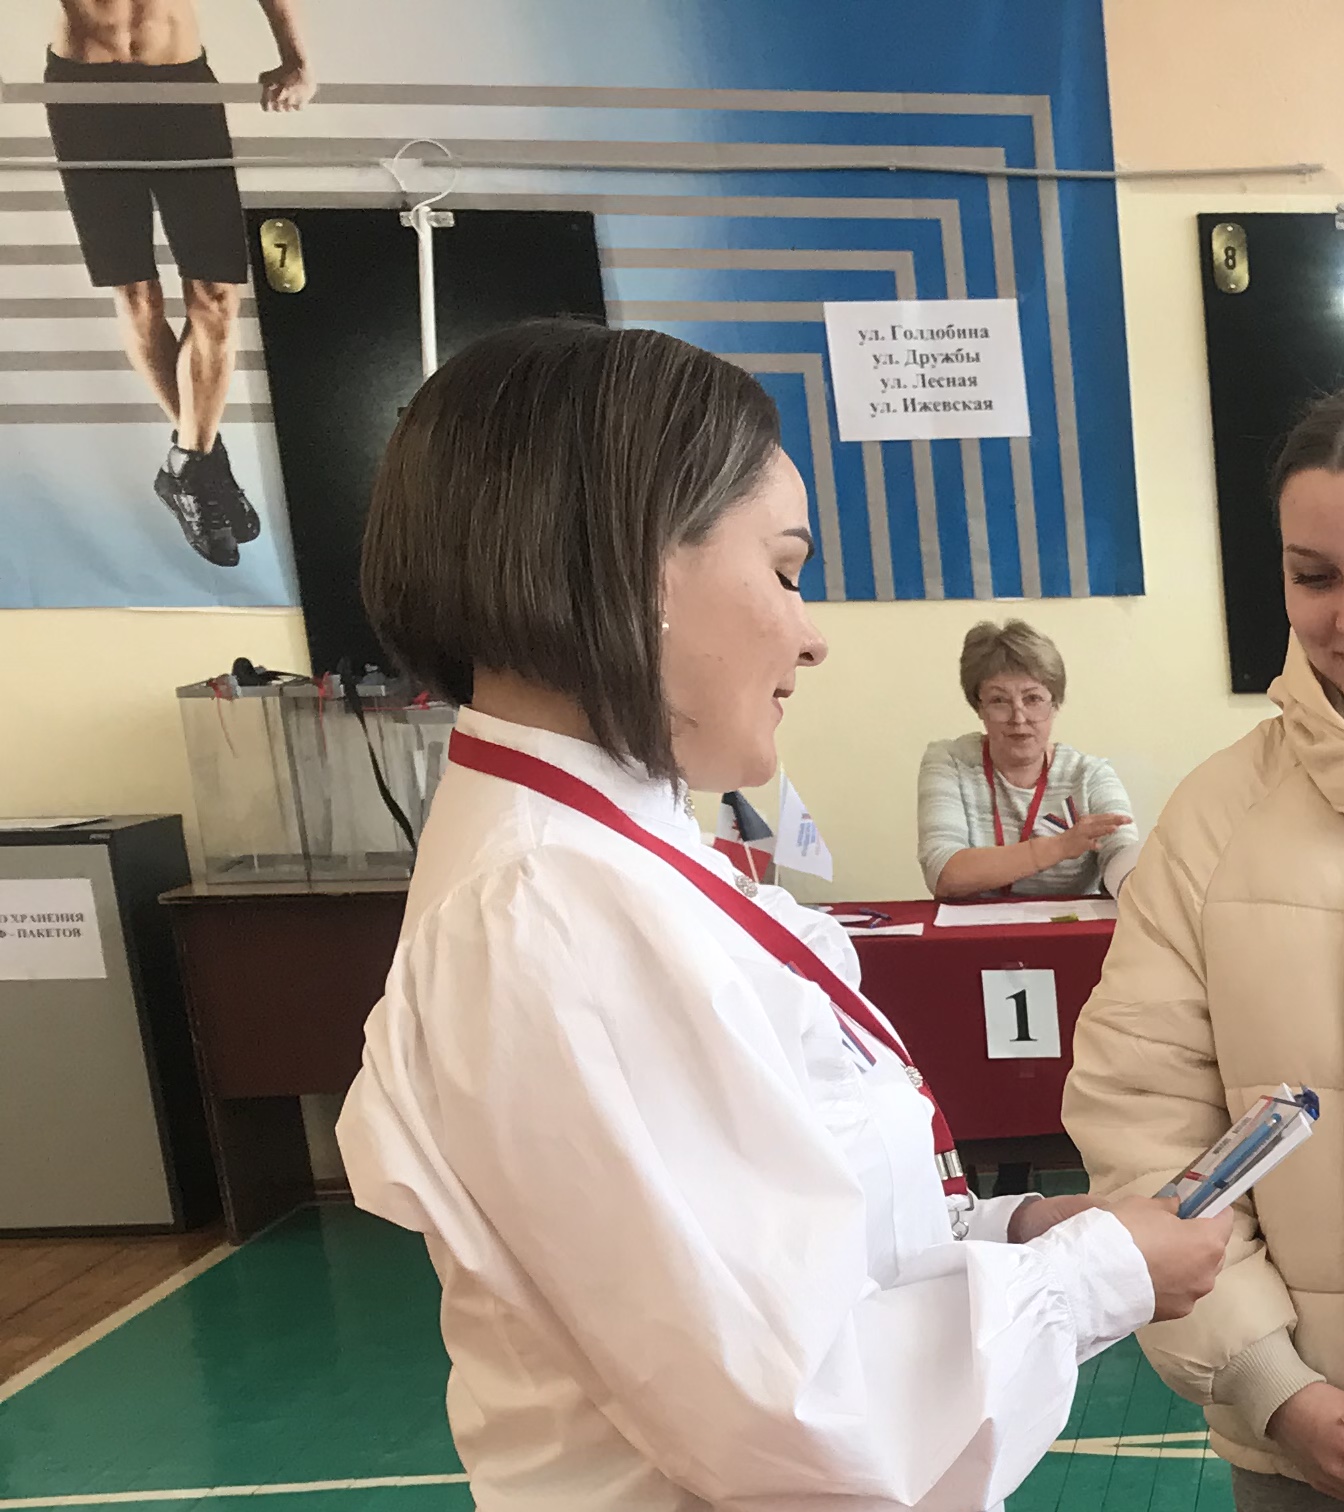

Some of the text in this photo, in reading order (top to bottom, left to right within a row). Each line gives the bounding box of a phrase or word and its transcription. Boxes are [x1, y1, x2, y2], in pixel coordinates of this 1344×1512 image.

[273, 243, 287, 268] 7
[1224, 246, 1236, 270] 8
[858, 324, 990, 346] ул. Голдобина
[872, 348, 981, 370] ул. Дружбы
[880, 373, 978, 393] ул. Лесная
[869, 398, 994, 418] ул. Ижевская
[9, 911, 84, 924] ХРАНЕНИЯ
[17, 927, 82, 939] ПАКЕТОВ
[1005, 988, 1038, 1042] 1
